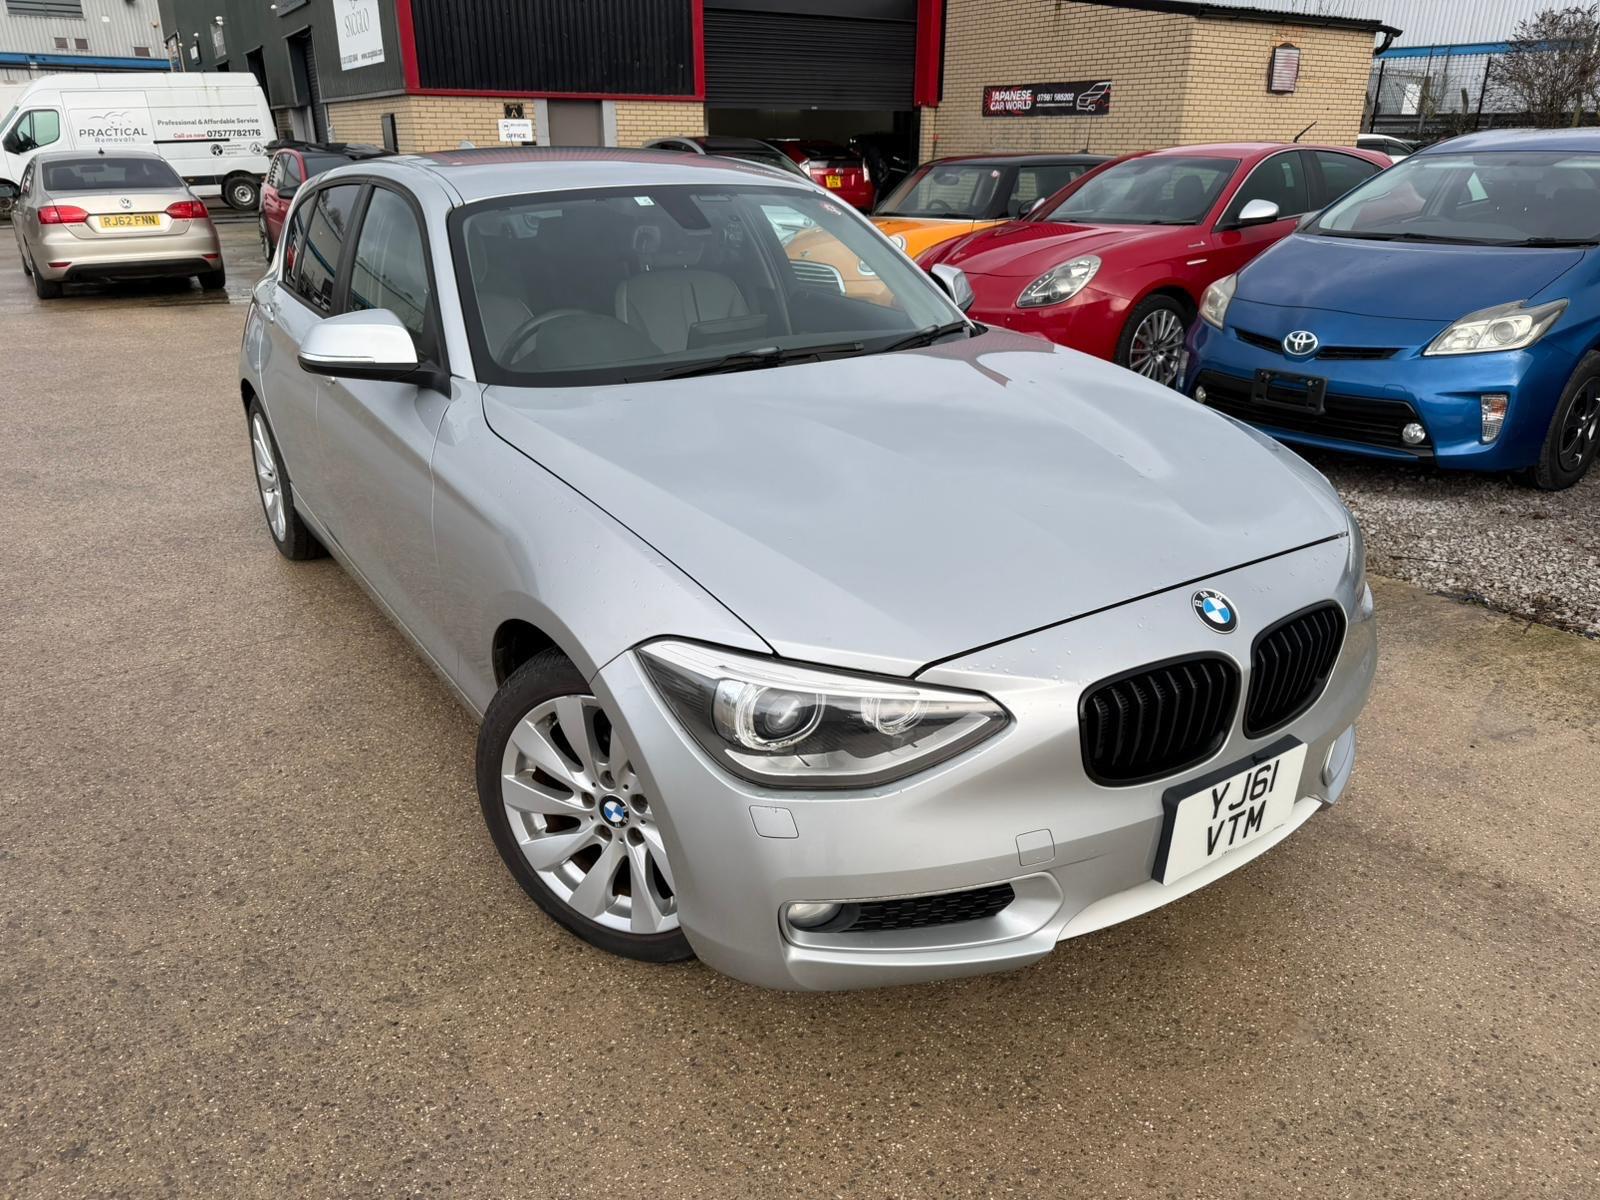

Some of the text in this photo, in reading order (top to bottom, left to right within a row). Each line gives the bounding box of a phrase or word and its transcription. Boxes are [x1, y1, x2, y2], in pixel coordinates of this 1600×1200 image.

[991, 90, 1032, 101] JAPANESE
[990, 102, 1005, 111] CAR
[1005, 101, 1032, 110] WORLD
[203, 117, 235, 125] Affordable
[79, 127, 148, 138] PRACTICAL
[206, 128, 261, 138] 07577782176
[94, 136, 136, 144] Removals
[104, 214, 156, 227] RJ62 FNN
[1211, 758, 1280, 820] YJ61
[1207, 799, 1267, 857] VTM
